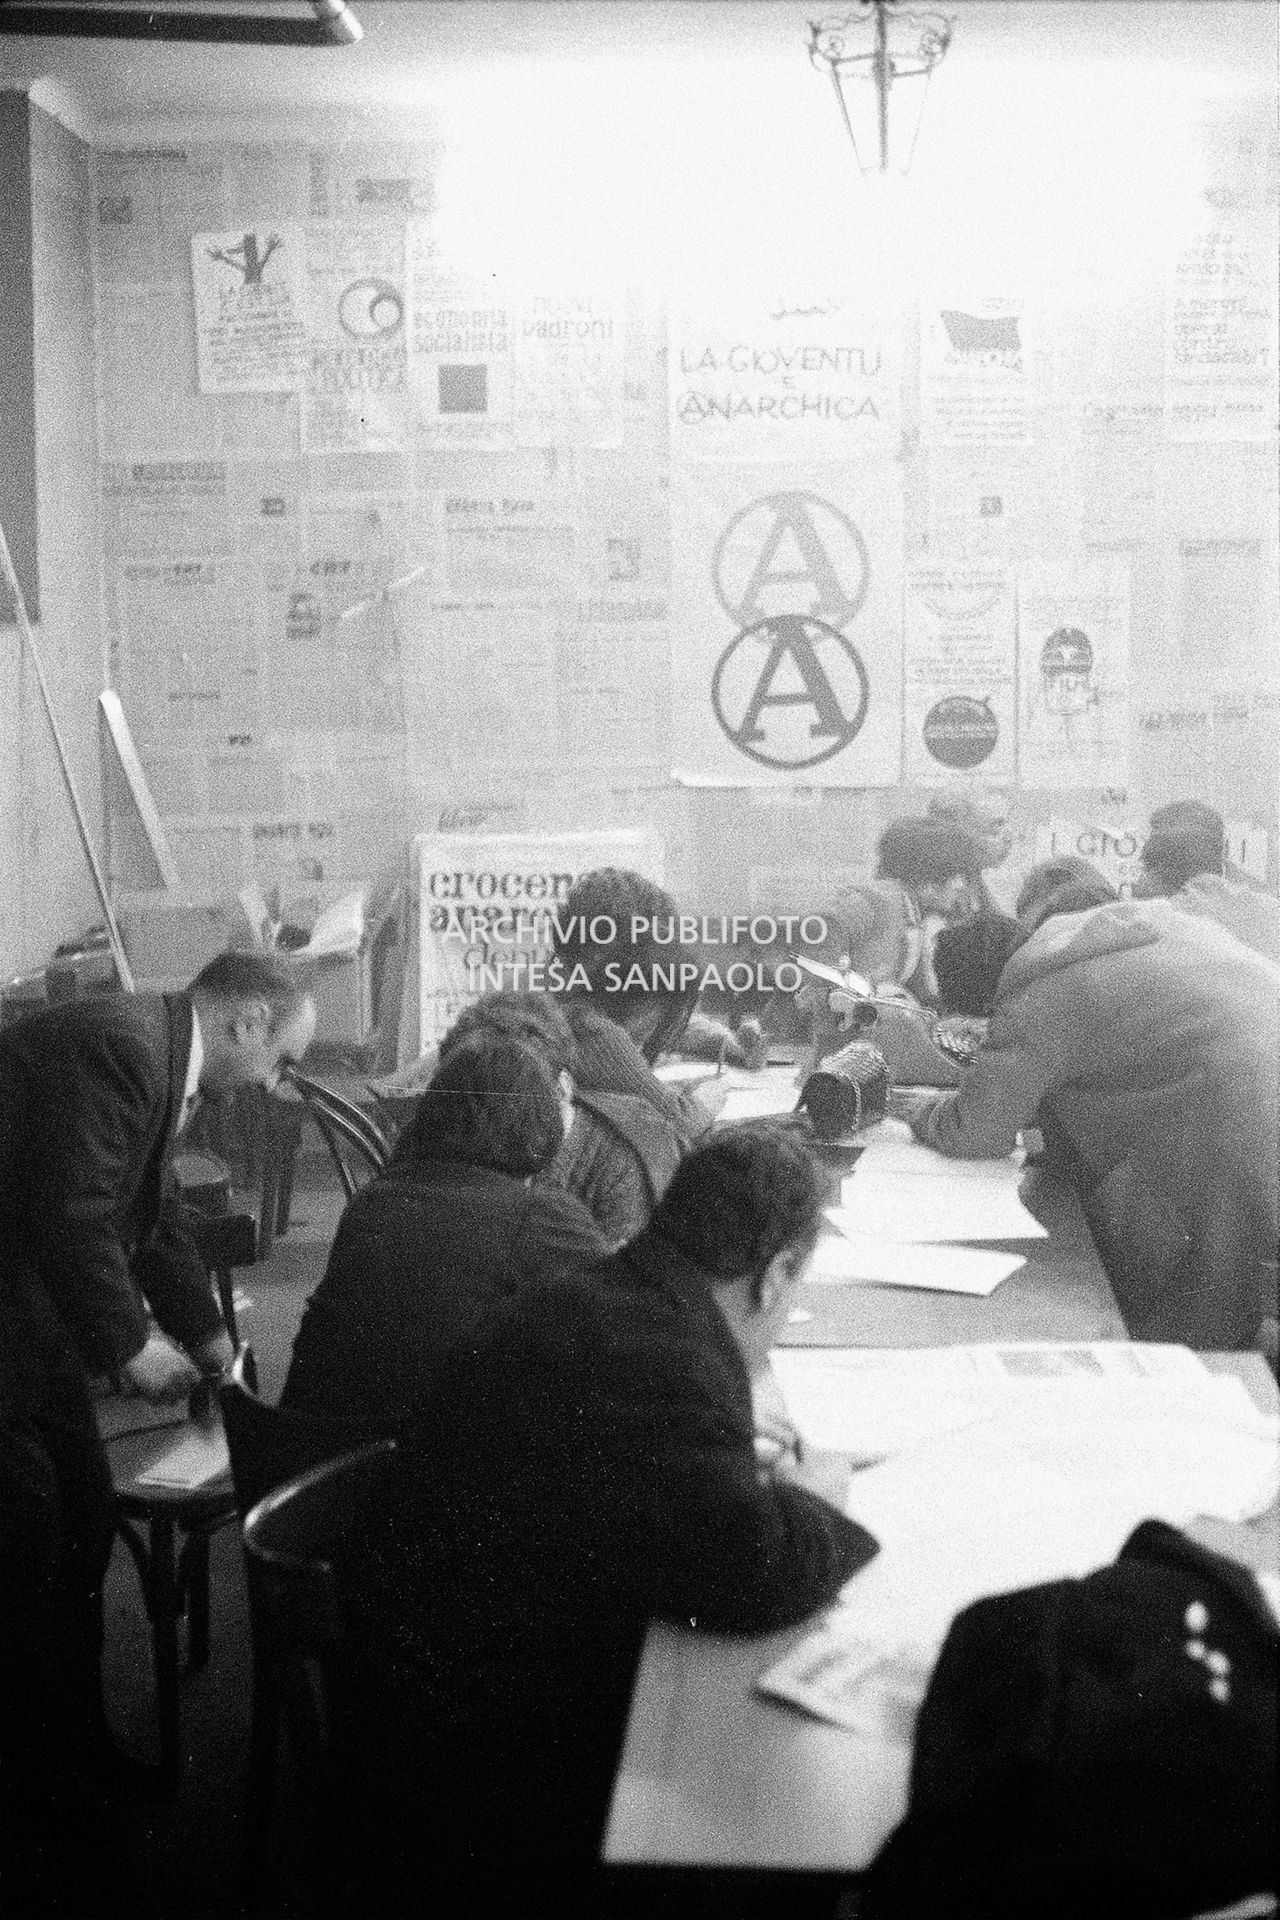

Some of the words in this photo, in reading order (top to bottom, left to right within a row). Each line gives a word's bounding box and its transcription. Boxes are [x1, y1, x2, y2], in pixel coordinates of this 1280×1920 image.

[679, 346, 718, 374] LA
[676, 390, 880, 424] ANARCHICA
[430, 871, 574, 900] crocen
[430, 904, 555, 934] anarc
